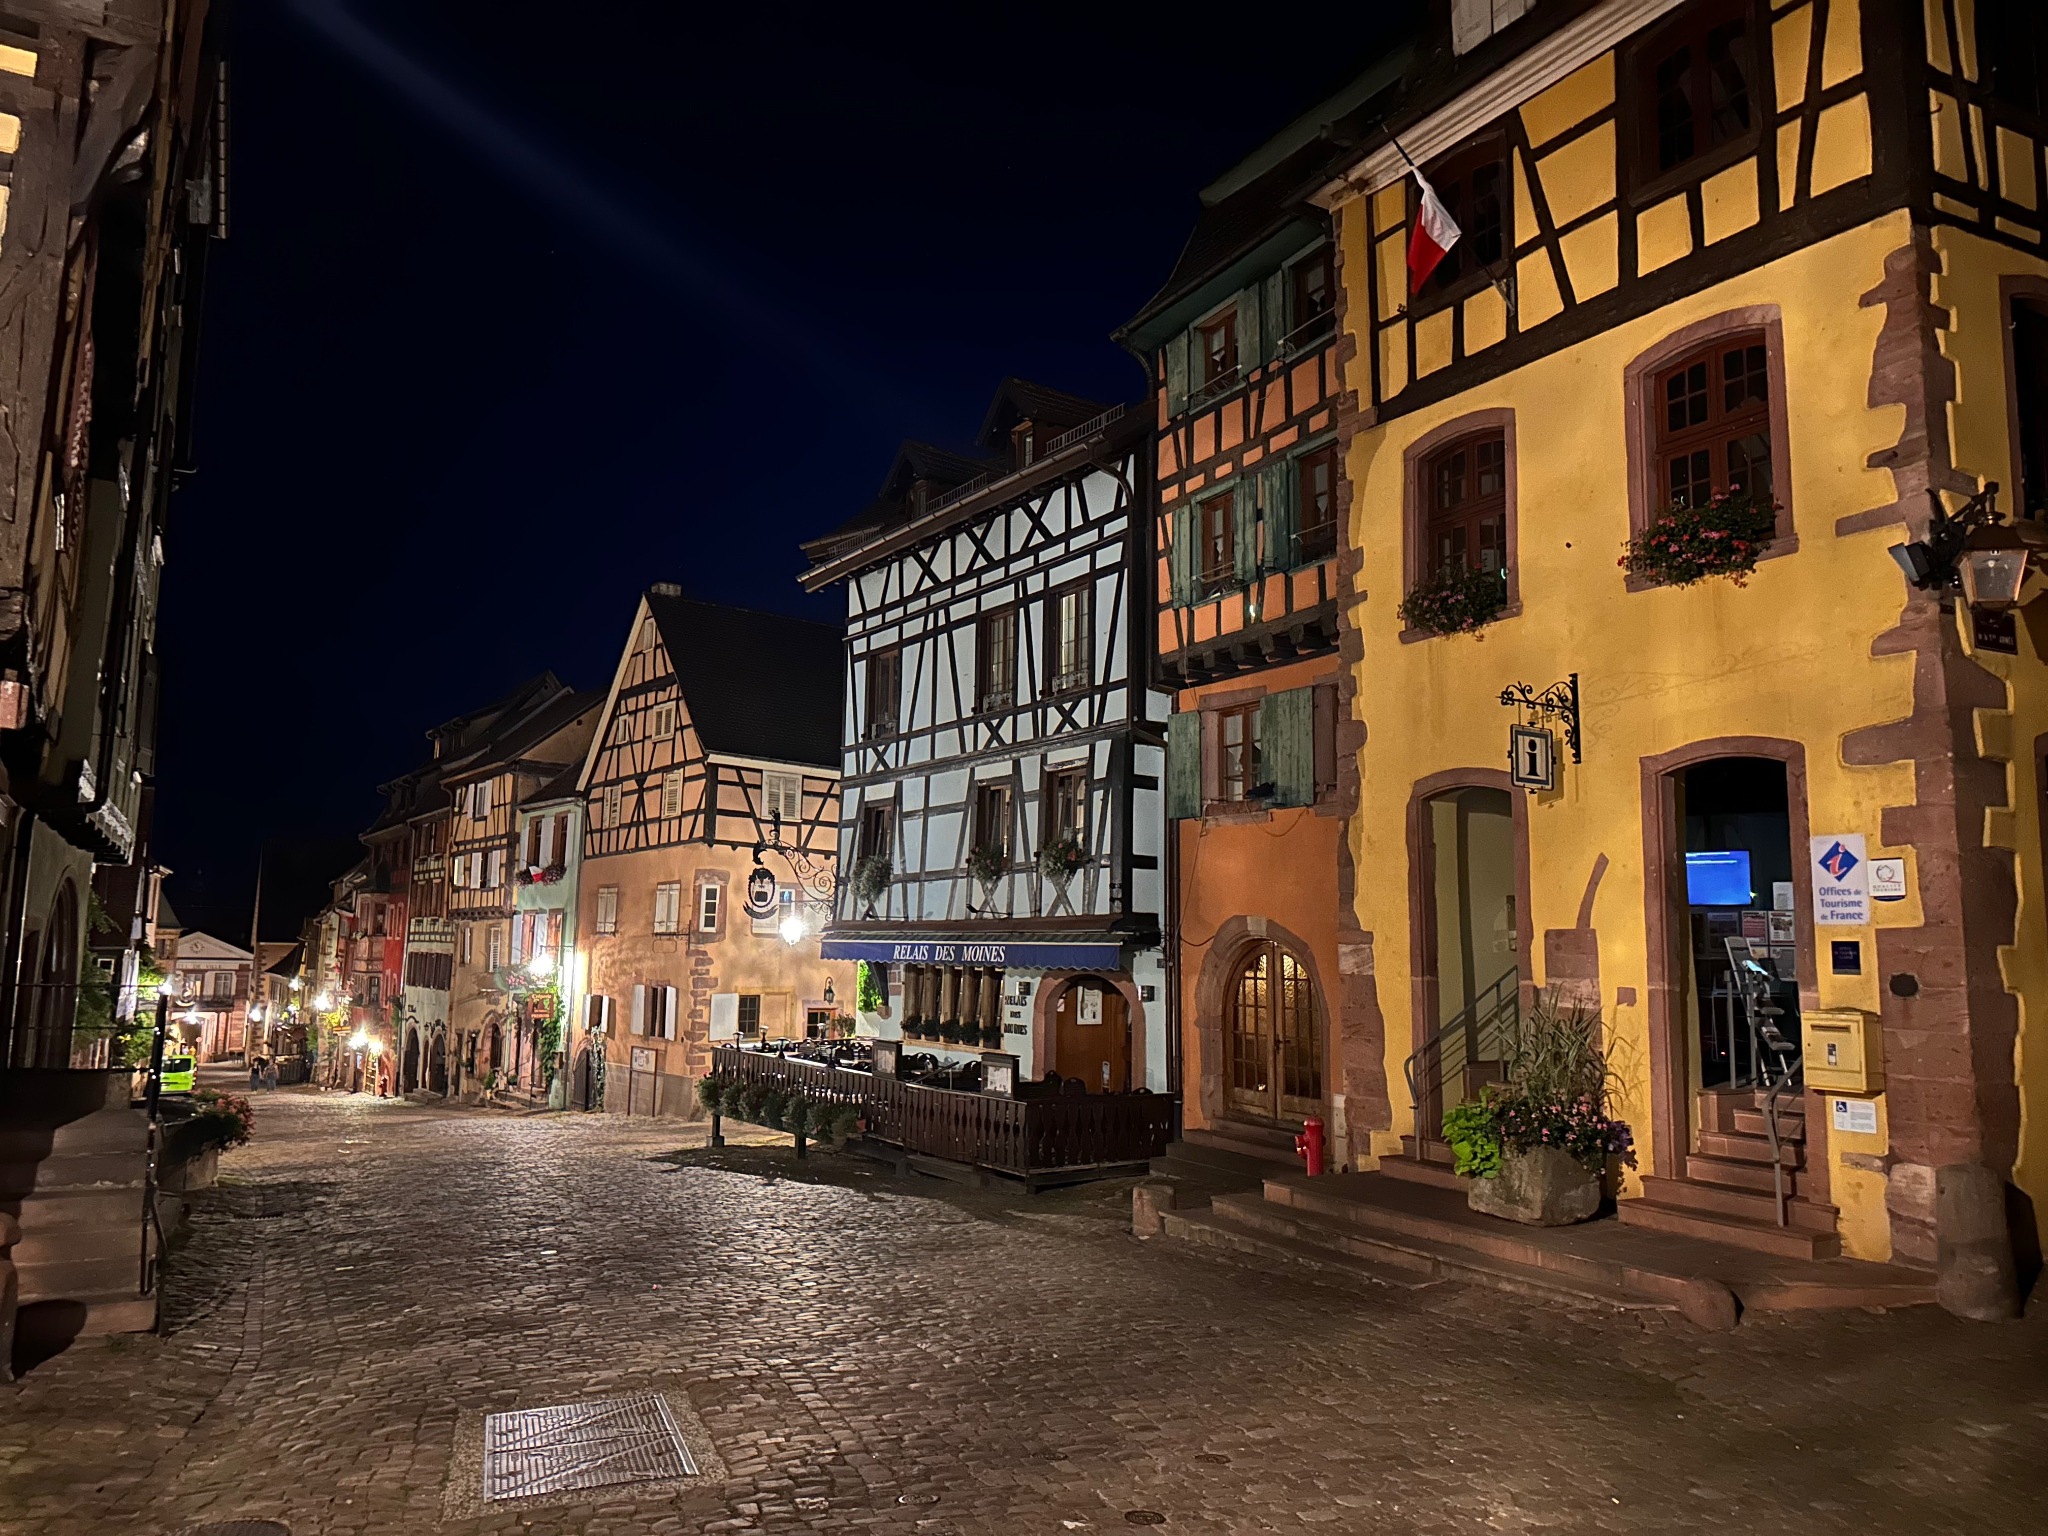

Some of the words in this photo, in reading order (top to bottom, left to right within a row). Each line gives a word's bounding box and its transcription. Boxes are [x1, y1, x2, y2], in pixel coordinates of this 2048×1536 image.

[1819, 887, 1852, 896] Offices
[1820, 898, 1863, 908] Tourisme
[1830, 911, 1864, 920] France
[893, 945, 929, 960] RELAIS
[934, 945, 956, 961] DES
[961, 946, 1006, 962] MOINES
